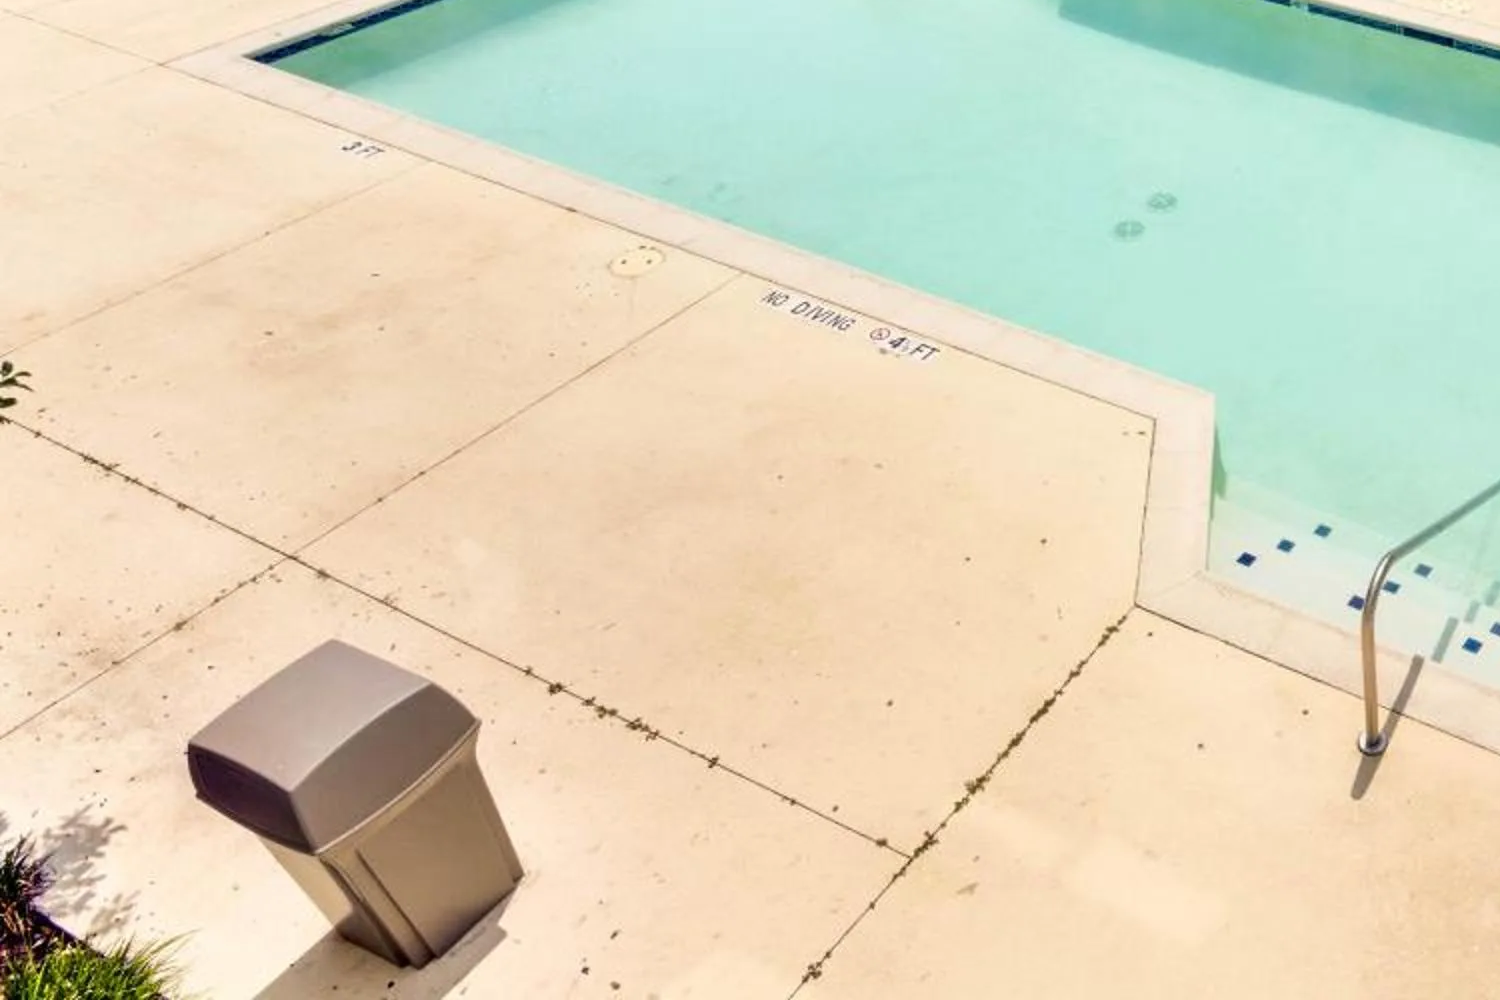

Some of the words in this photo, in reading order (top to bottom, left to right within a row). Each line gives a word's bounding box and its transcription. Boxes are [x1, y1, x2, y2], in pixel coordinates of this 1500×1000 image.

[341, 141, 362, 151] 3
[354, 145, 385, 159] FT
[761, 291, 789, 306] NO
[790, 301, 856, 331] DIVING
[909, 343, 941, 360] FT
